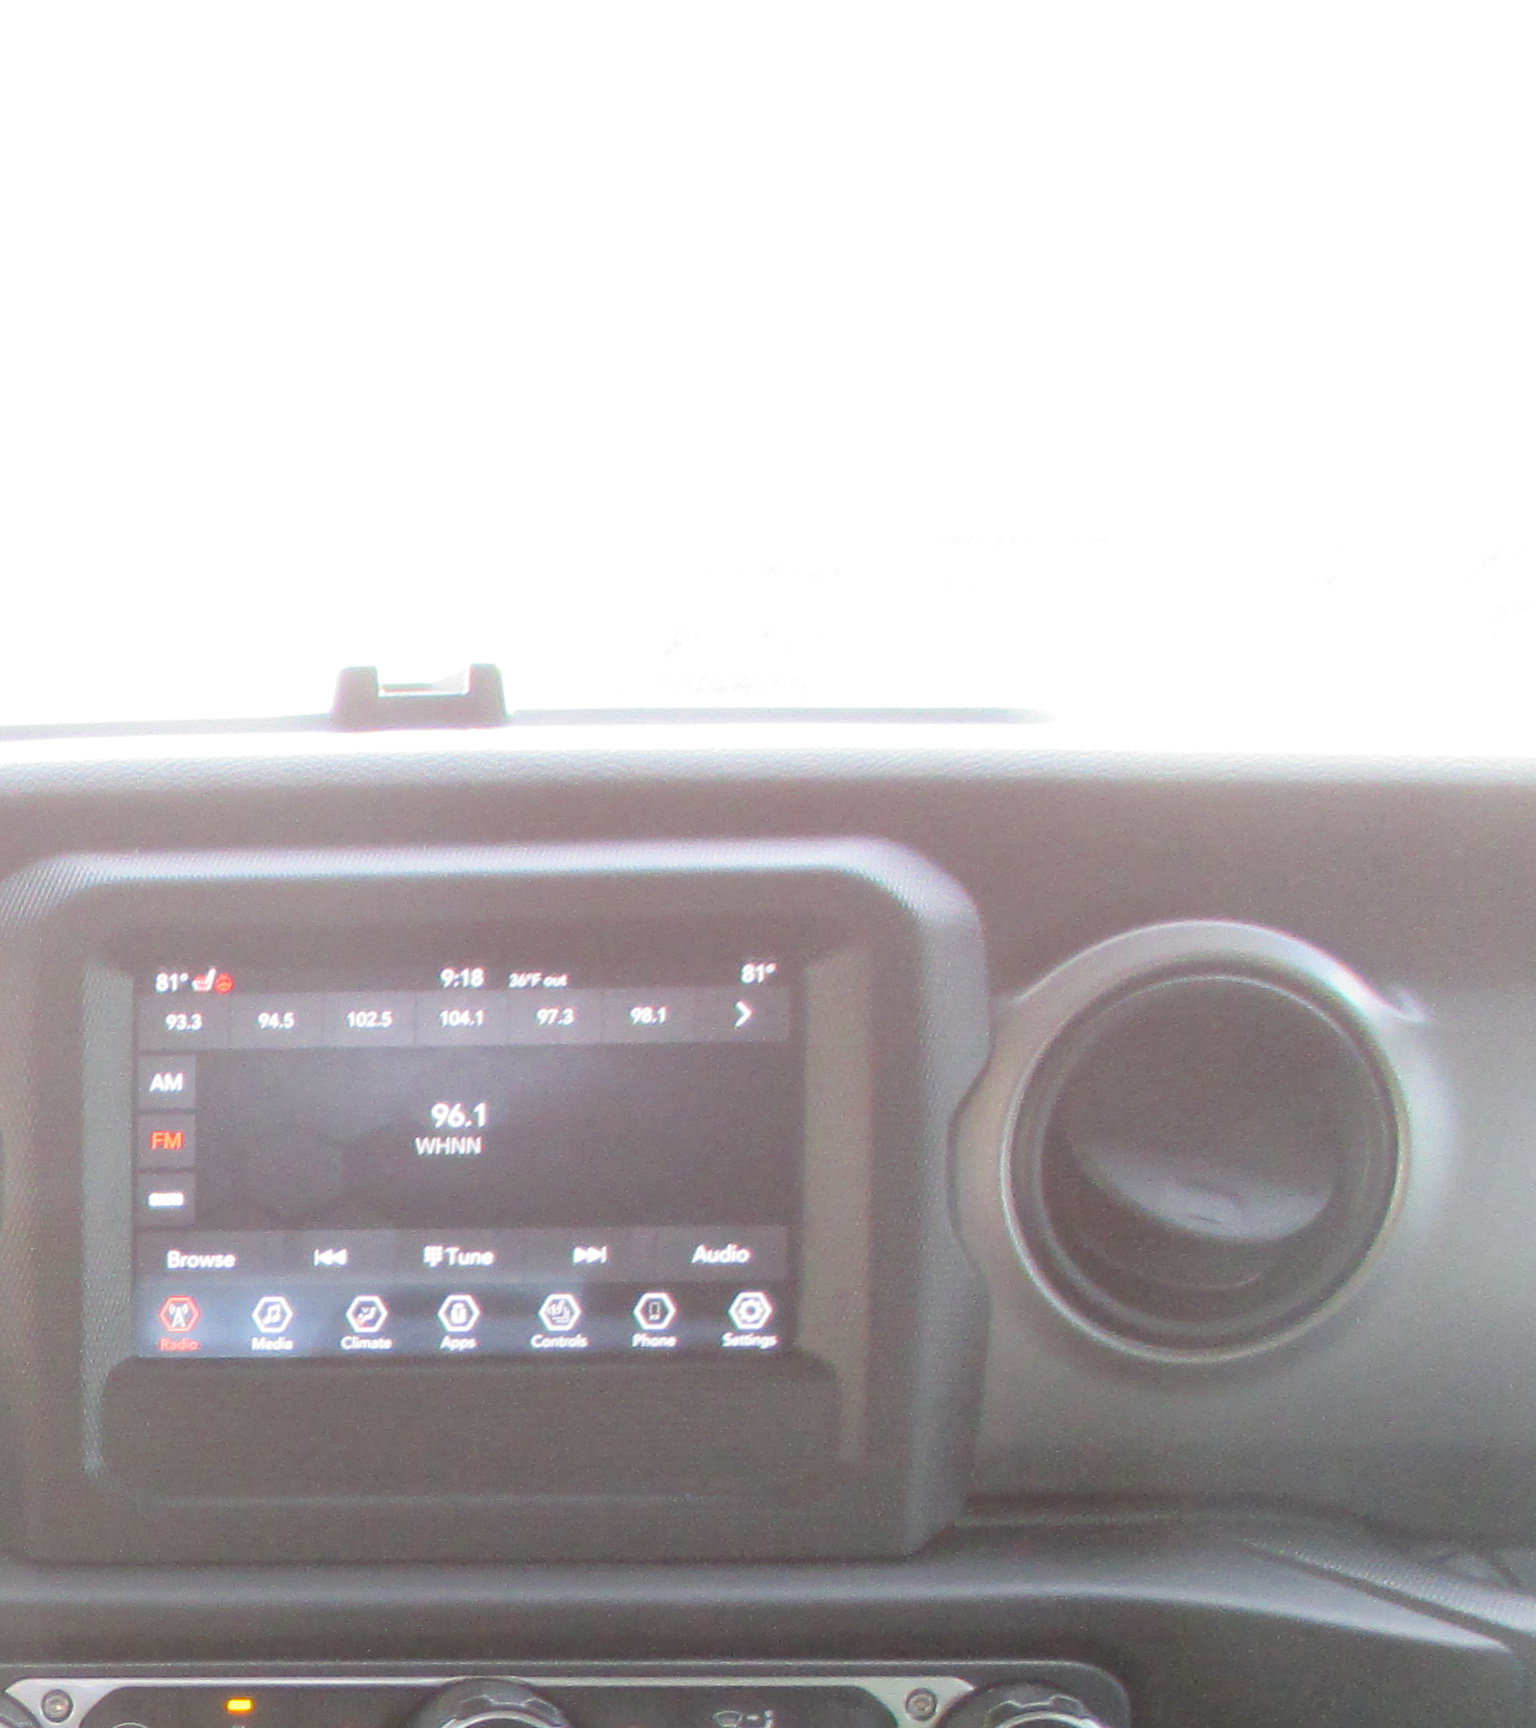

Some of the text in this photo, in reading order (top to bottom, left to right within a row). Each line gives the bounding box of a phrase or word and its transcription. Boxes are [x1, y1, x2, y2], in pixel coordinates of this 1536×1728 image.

[439, 968, 484, 988] 9:18
[165, 1013, 202, 1031] 93.3
[258, 1012, 294, 1030] 94.5
[347, 1011, 392, 1028] 102.5
[440, 1010, 484, 1027] 104.1
[536, 1008, 574, 1025] 97.3
[630, 1007, 667, 1024] 98.1
[150, 1073, 182, 1092] AM
[431, 1102, 487, 1128] 96.1
[151, 1131, 183, 1149] FM
[415, 1136, 483, 1156] WHNN
[167, 1250, 236, 1269] Browse
[446, 1248, 495, 1267] Tune
[691, 1244, 751, 1264] Audio
[160, 1338, 200, 1351] Radio
[251, 1337, 294, 1351] Media
[341, 1336, 392, 1350] Climate
[441, 1336, 477, 1350] Apps
[530, 1334, 588, 1349] Controls
[633, 1333, 677, 1348] Phone
[722, 1332, 778, 1349] Settings
